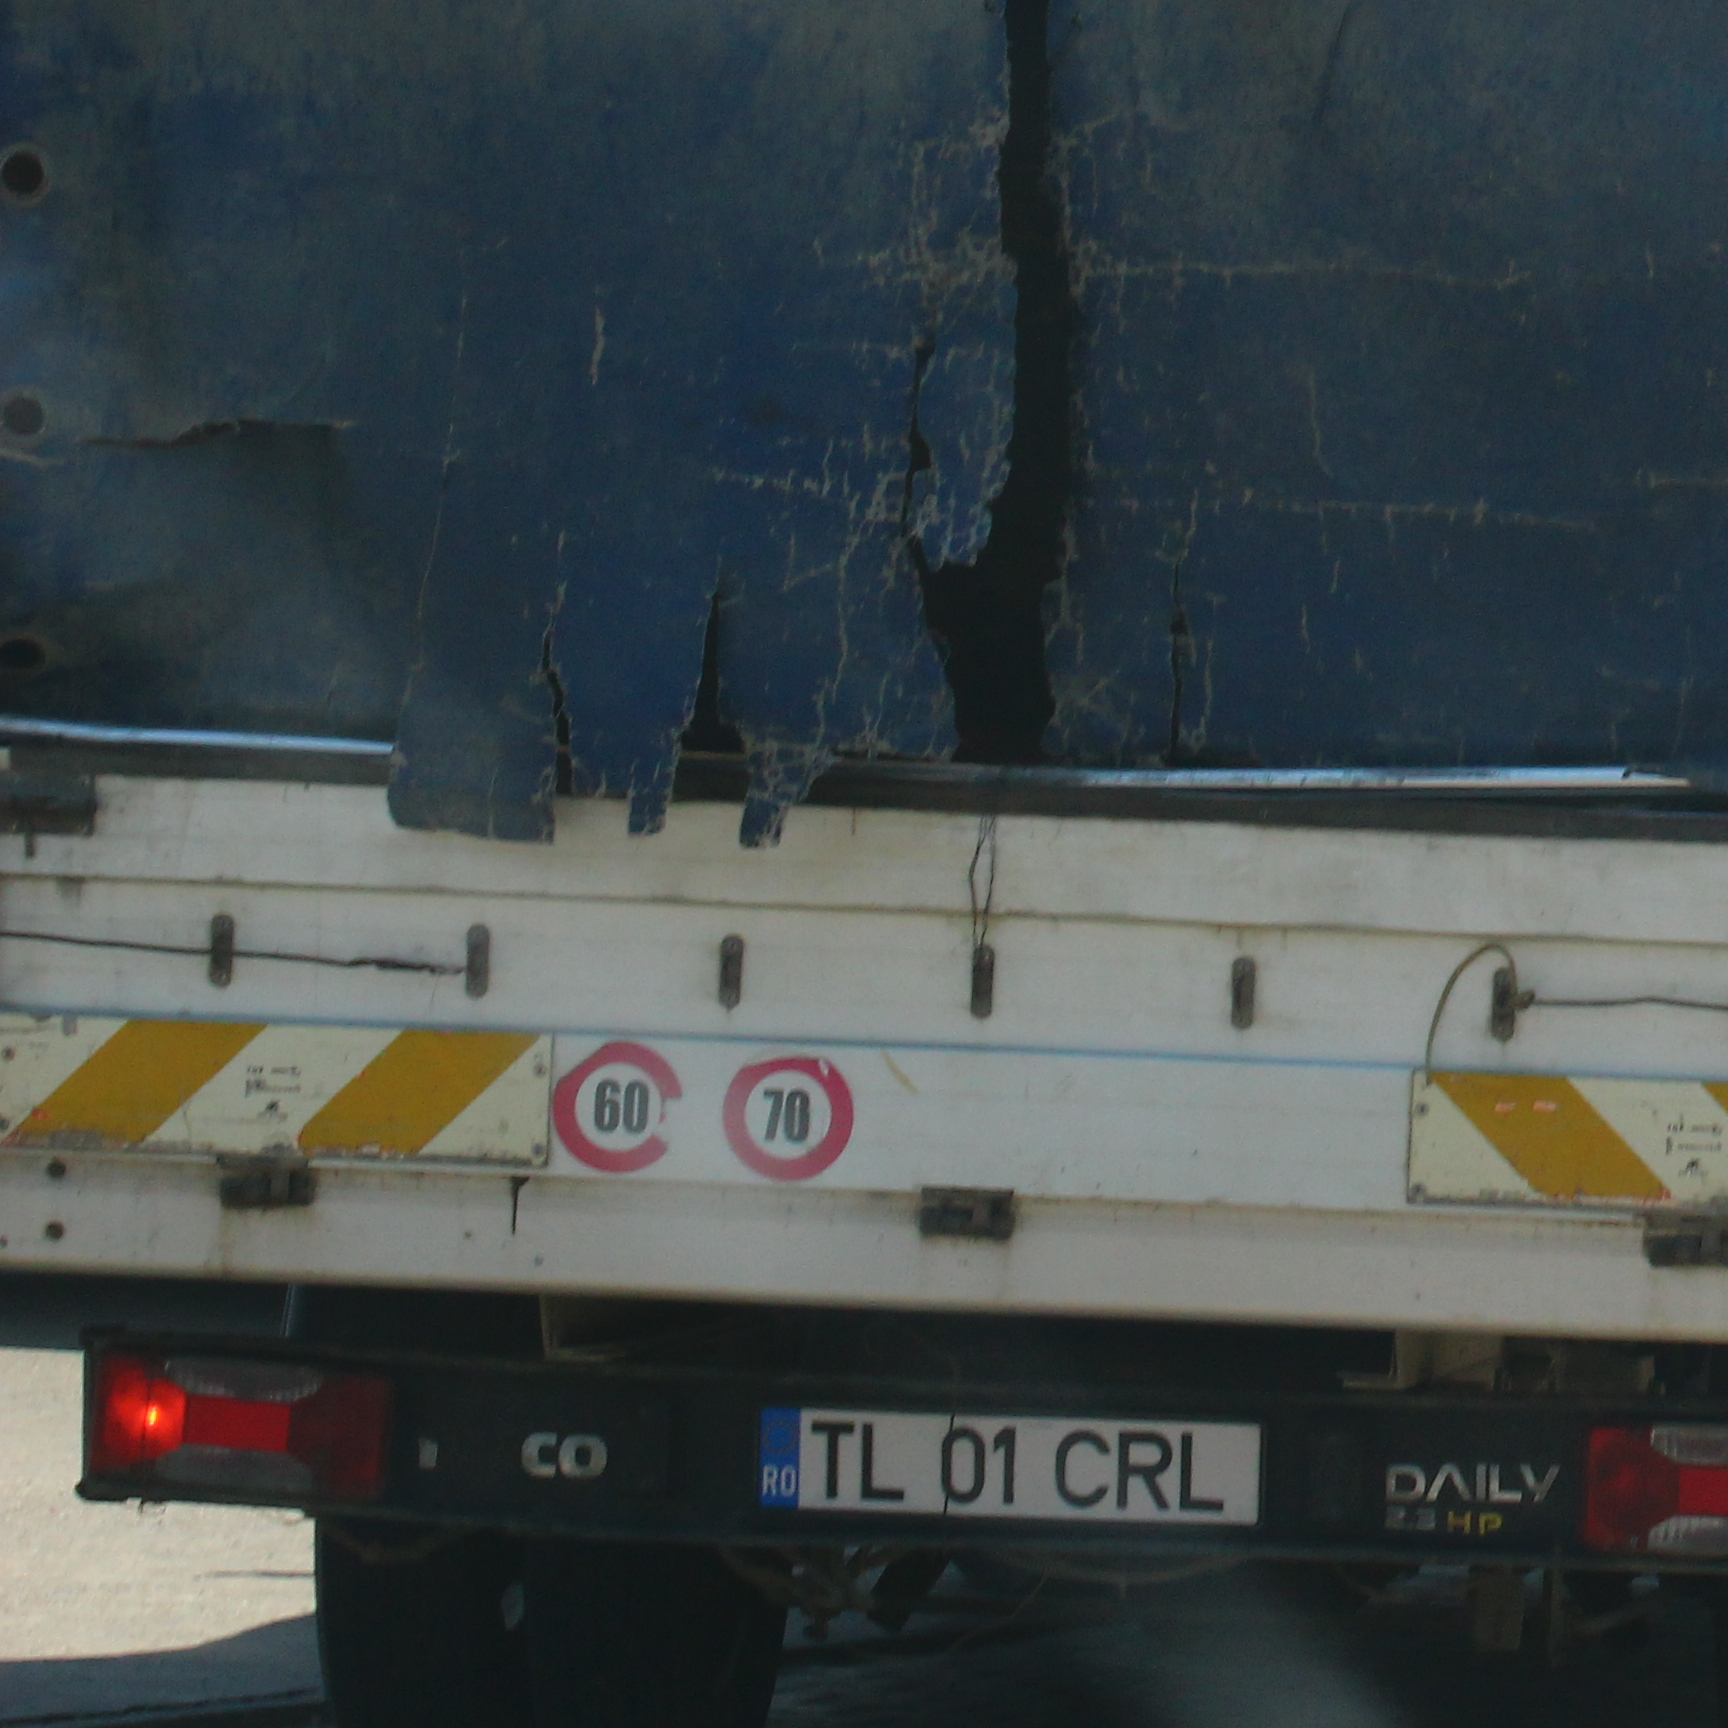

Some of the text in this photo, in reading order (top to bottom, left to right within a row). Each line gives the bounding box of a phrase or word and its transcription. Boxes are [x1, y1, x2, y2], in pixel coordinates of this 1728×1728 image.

[594, 1079, 650, 1134] 60
[763, 1089, 811, 1142] 70
[761, 1464, 797, 1498] RO
[811, 1420, 1224, 1513] TL 01 CRL
[1385, 1462, 1561, 1504] DAILY
[1447, 1510, 1503, 1536] HP
